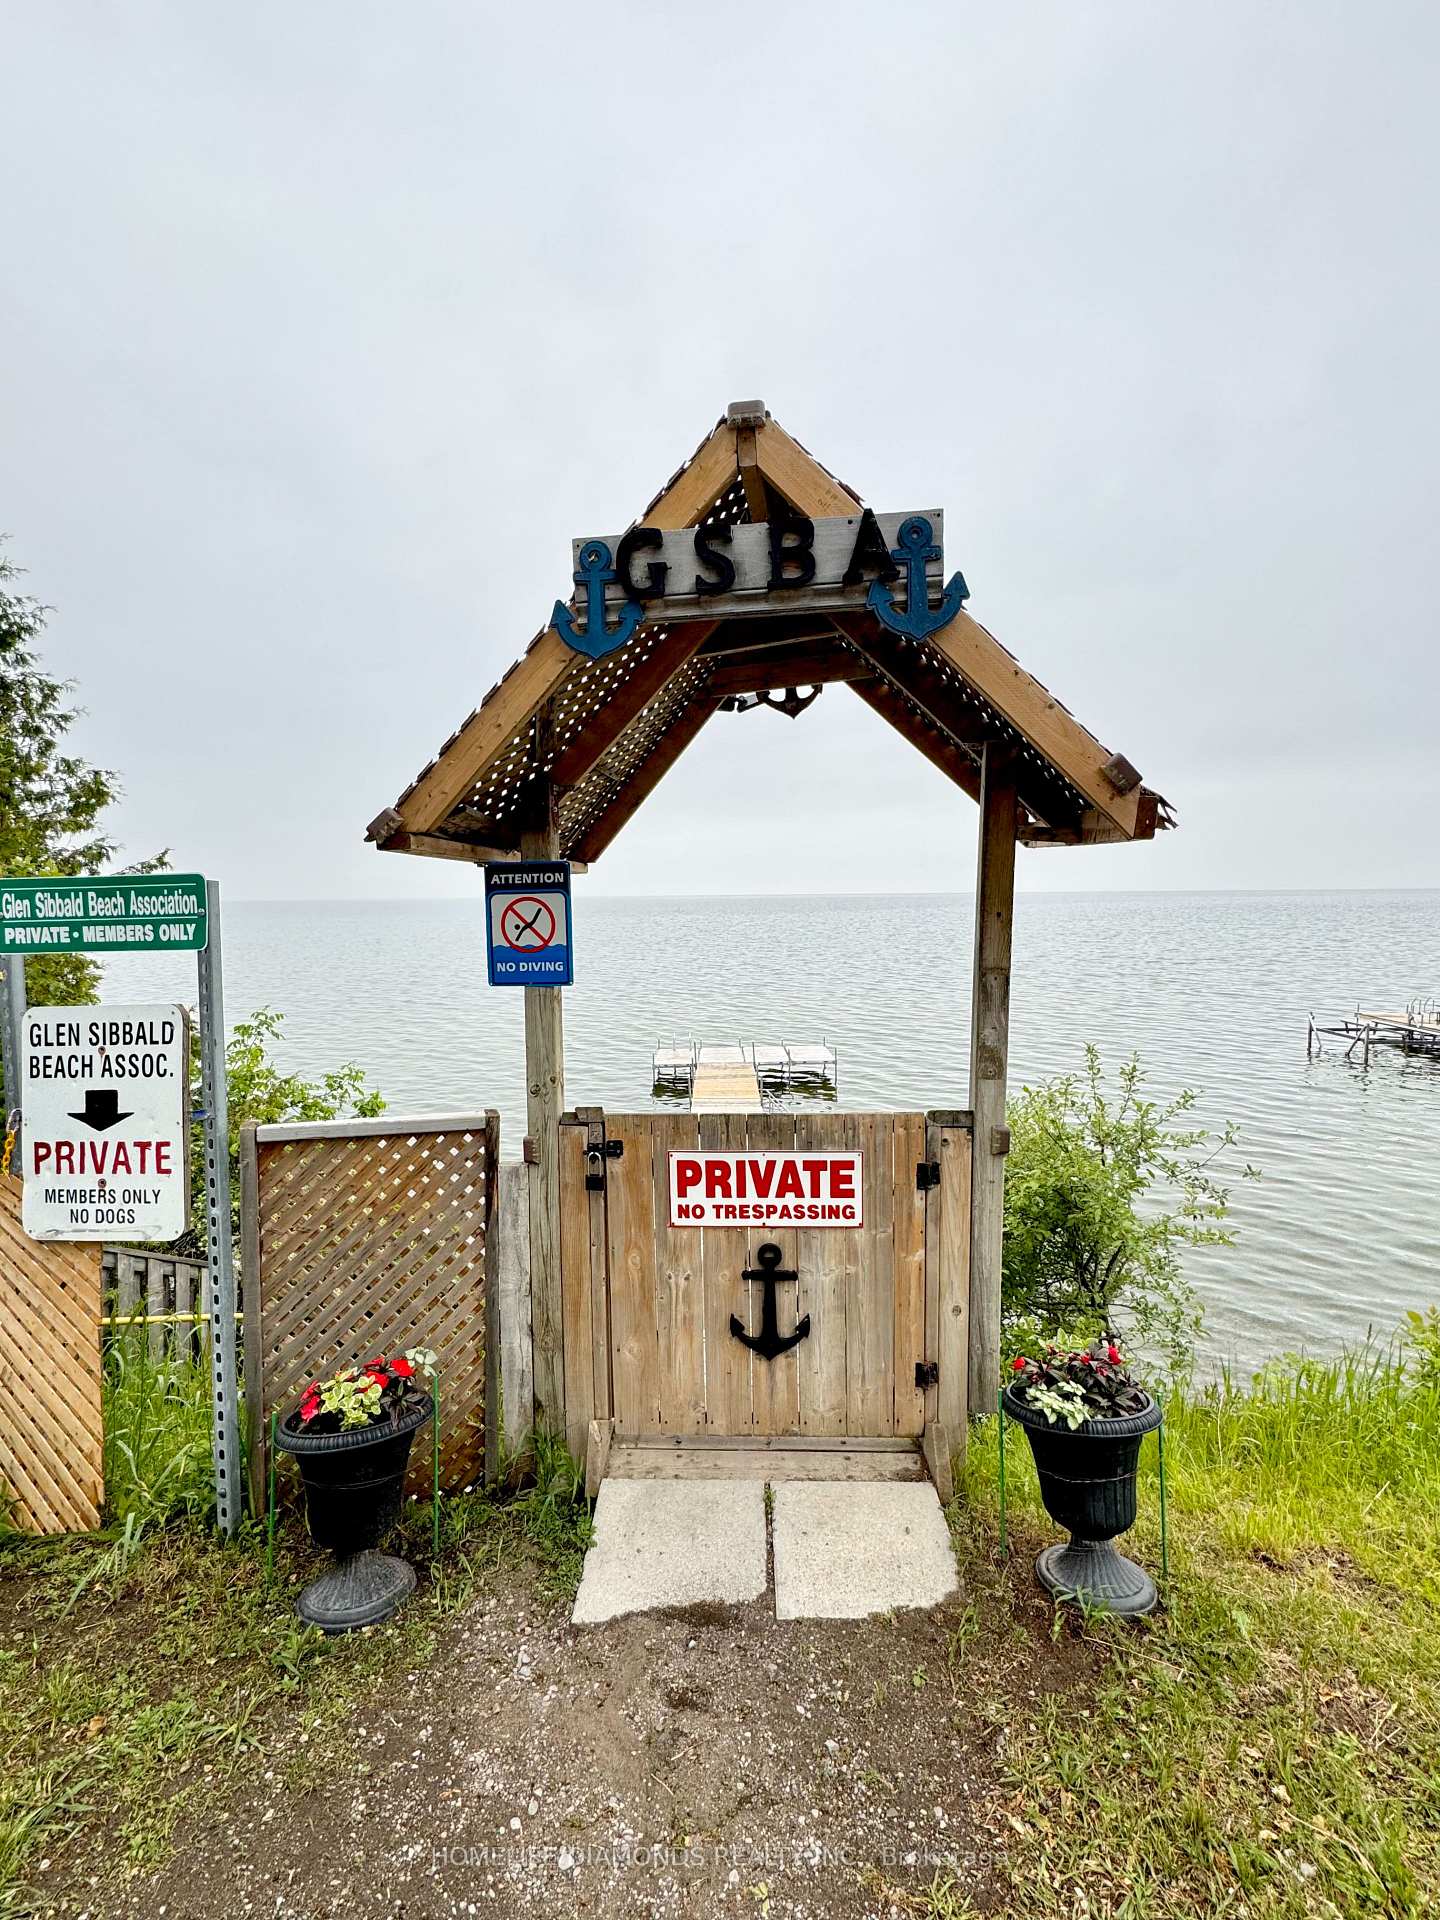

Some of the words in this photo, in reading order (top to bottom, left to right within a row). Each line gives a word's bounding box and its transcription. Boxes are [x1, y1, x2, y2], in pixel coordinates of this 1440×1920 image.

[490, 872, 564, 885] ATTENTION
[2, 893, 31, 919] Glen
[35, 891, 83, 918] Sibbald
[88, 890, 125, 917] Beach
[130, 889, 197, 915] Association
[4, 927, 71, 944] PRIVATE
[82, 925, 154, 942] MEMBERS
[159, 924, 197, 941] ONLY
[496, 962, 515, 972] NO
[519, 961, 564, 972] DIVING
[29, 1023, 80, 1047] GLEN
[88, 1021, 174, 1046] SIBBALD
[29, 1055, 93, 1079] BEACH
[100, 1053, 174, 1078] ASSOC.
[33, 1141, 172, 1175] PRIVATE
[676, 1160, 855, 1198] PRIVATE
[44, 1189, 116, 1204] MEMBERS
[122, 1189, 161, 1204] ONLY
[70, 1209, 89, 1224] NO
[95, 1209, 135, 1224] DOGS
[677, 1204, 705, 1219] NO
[712, 1204, 856, 1219] TRESPASSING
